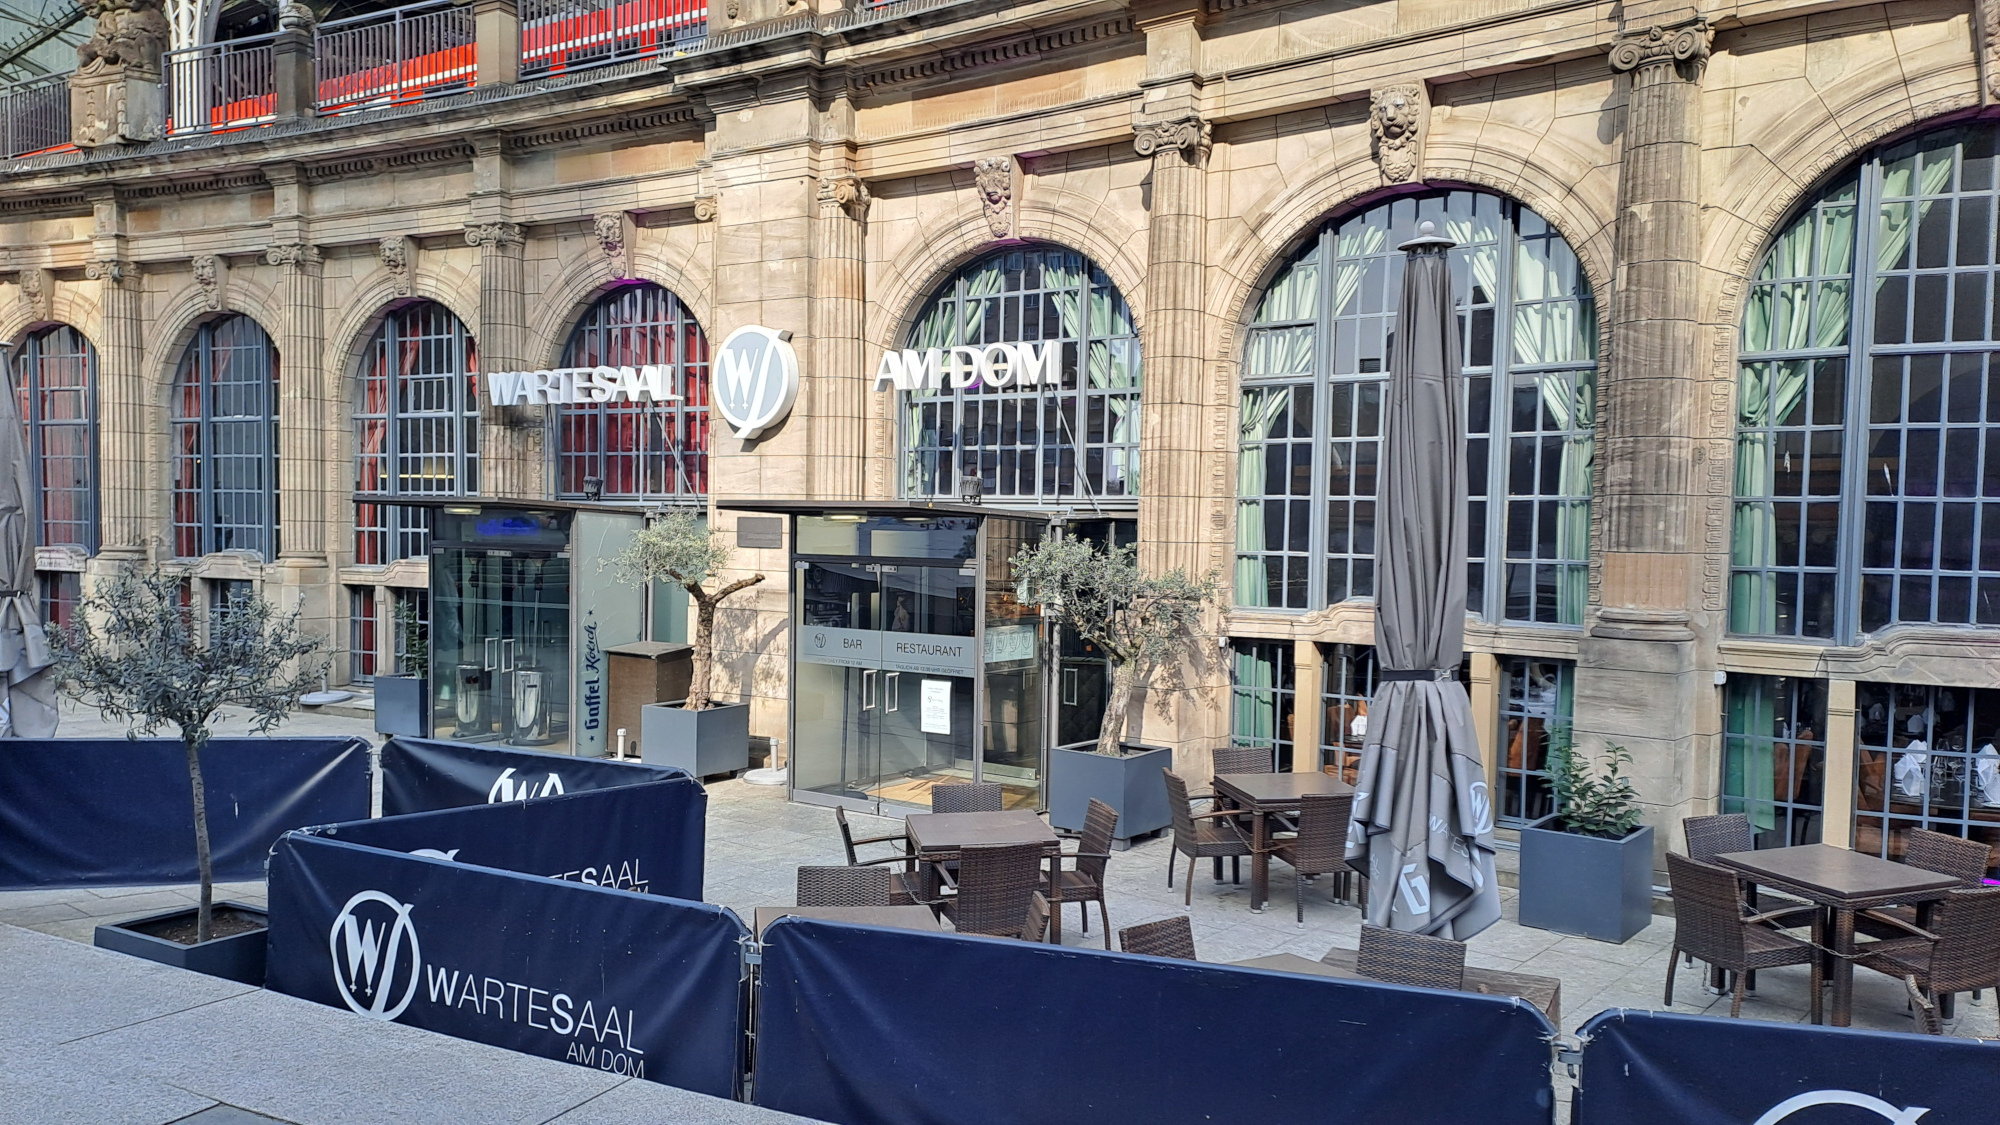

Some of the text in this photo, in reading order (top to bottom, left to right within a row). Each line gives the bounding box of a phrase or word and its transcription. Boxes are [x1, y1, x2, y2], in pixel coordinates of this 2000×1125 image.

[488, 364, 683, 406] WARTESAAL
[873, 339, 1062, 392] AM DOM
[843, 637, 863, 650] BAR
[896, 642, 963, 657] RESTAURANT
[585, 677, 600, 730] Gaffel
[427, 963, 644, 1054] WARTESAAL
[566, 1042, 645, 1079] AM DOM
